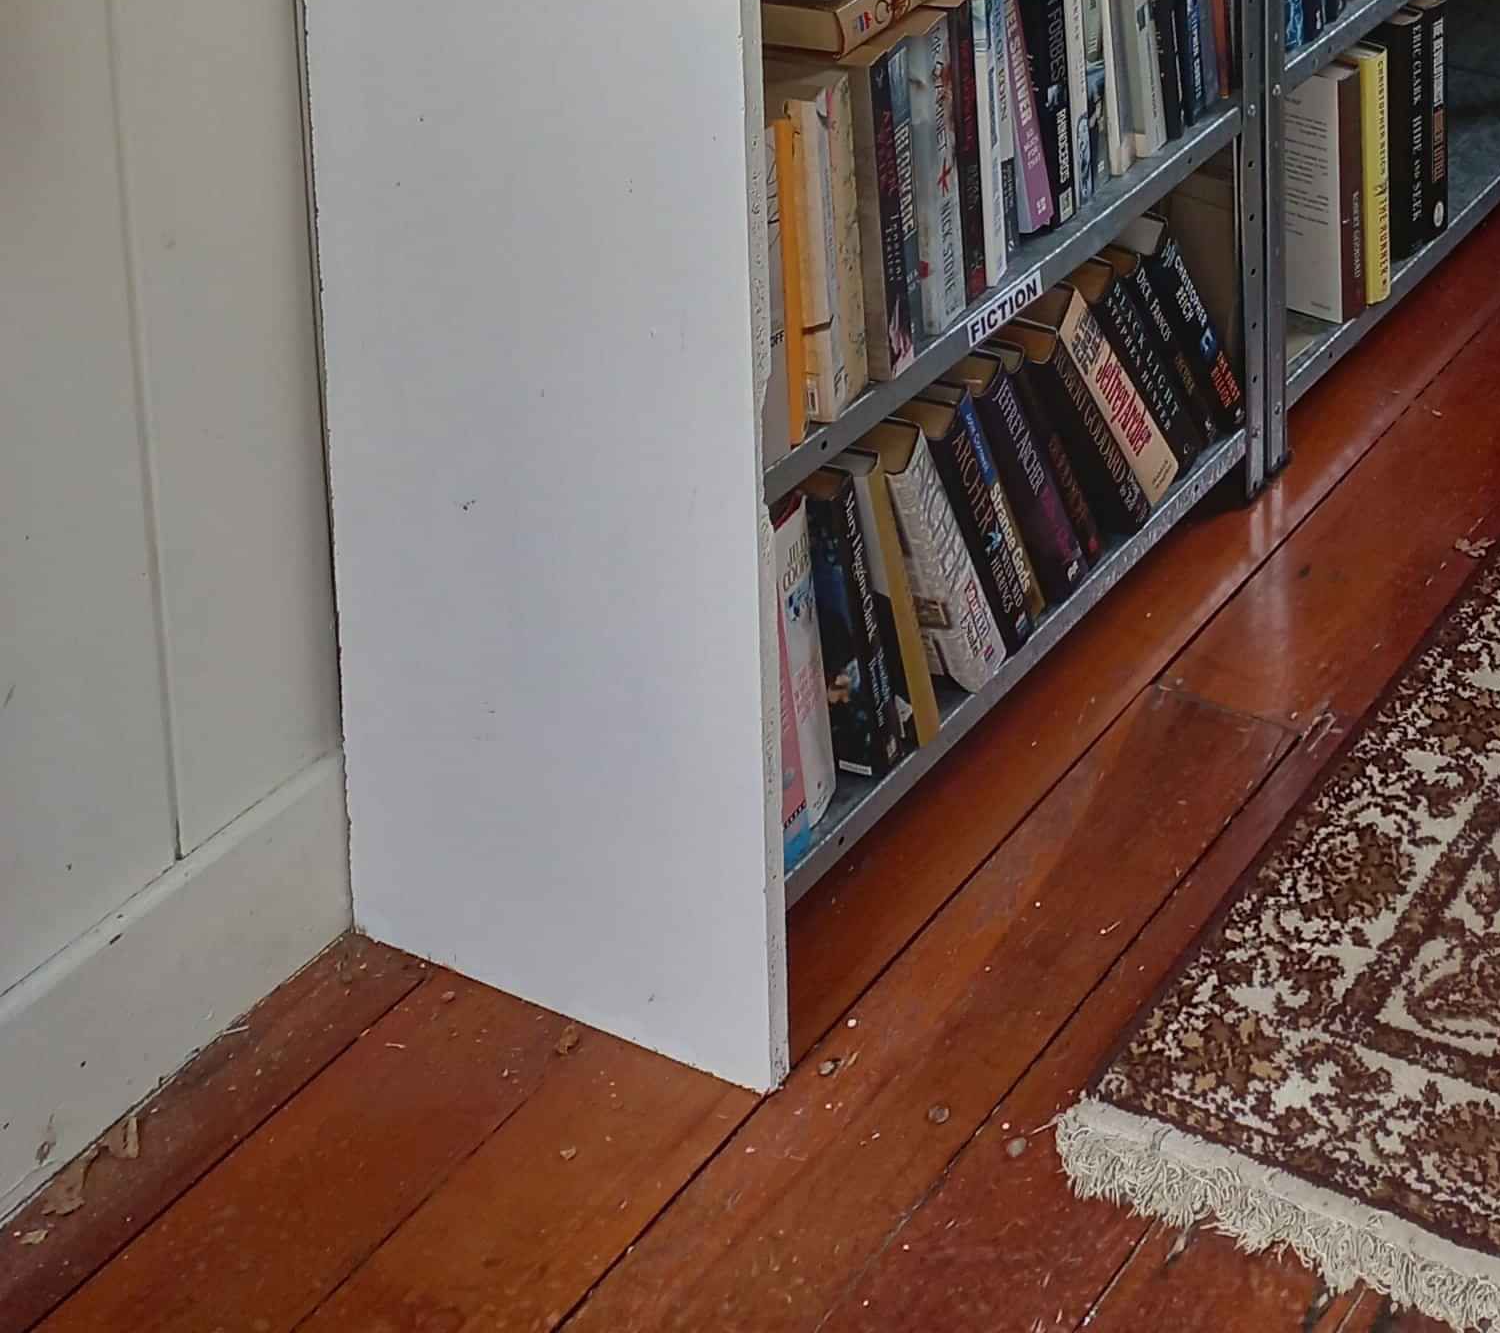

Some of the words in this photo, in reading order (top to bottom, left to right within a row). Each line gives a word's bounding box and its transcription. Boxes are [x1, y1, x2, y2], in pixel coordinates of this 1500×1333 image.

[1048, 12, 1066, 83] FORBES
[1412, 24, 1422, 58] ERIC
[1007, 33, 1034, 126] SHRIVER
[1377, 60, 1385, 137] CHRISTOPHER
[1412, 61, 1423, 106] CLARK
[1055, 108, 1071, 184] RHINOCEROS
[1412, 115, 1423, 156] HIDE
[1411, 182, 1423, 222] SEEK
[943, 247, 959, 294] STONE
[1378, 225, 1389, 276] RUNNER
[970, 278, 1038, 343] FICTION
[1105, 296, 1144, 366] STEPHEN
[1135, 268, 1154, 300] DICK
[1150, 299, 1171, 342] FRANCIS
[1175, 285, 1196, 322] REICH
[1113, 282, 1150, 349] BLACK
[1145, 351, 1181, 416] LIGHT
[992, 379, 1022, 438] JEFFREY
[1012, 433, 1046, 495] ARCHER
[844, 490, 858, 537] Mary
[952, 431, 996, 533] ARCHER
[850, 536, 868, 597] Higgins
[989, 482, 1017, 551] Strange
[1012, 548, 1033, 595] Gods
[861, 595, 880, 643] Clark
